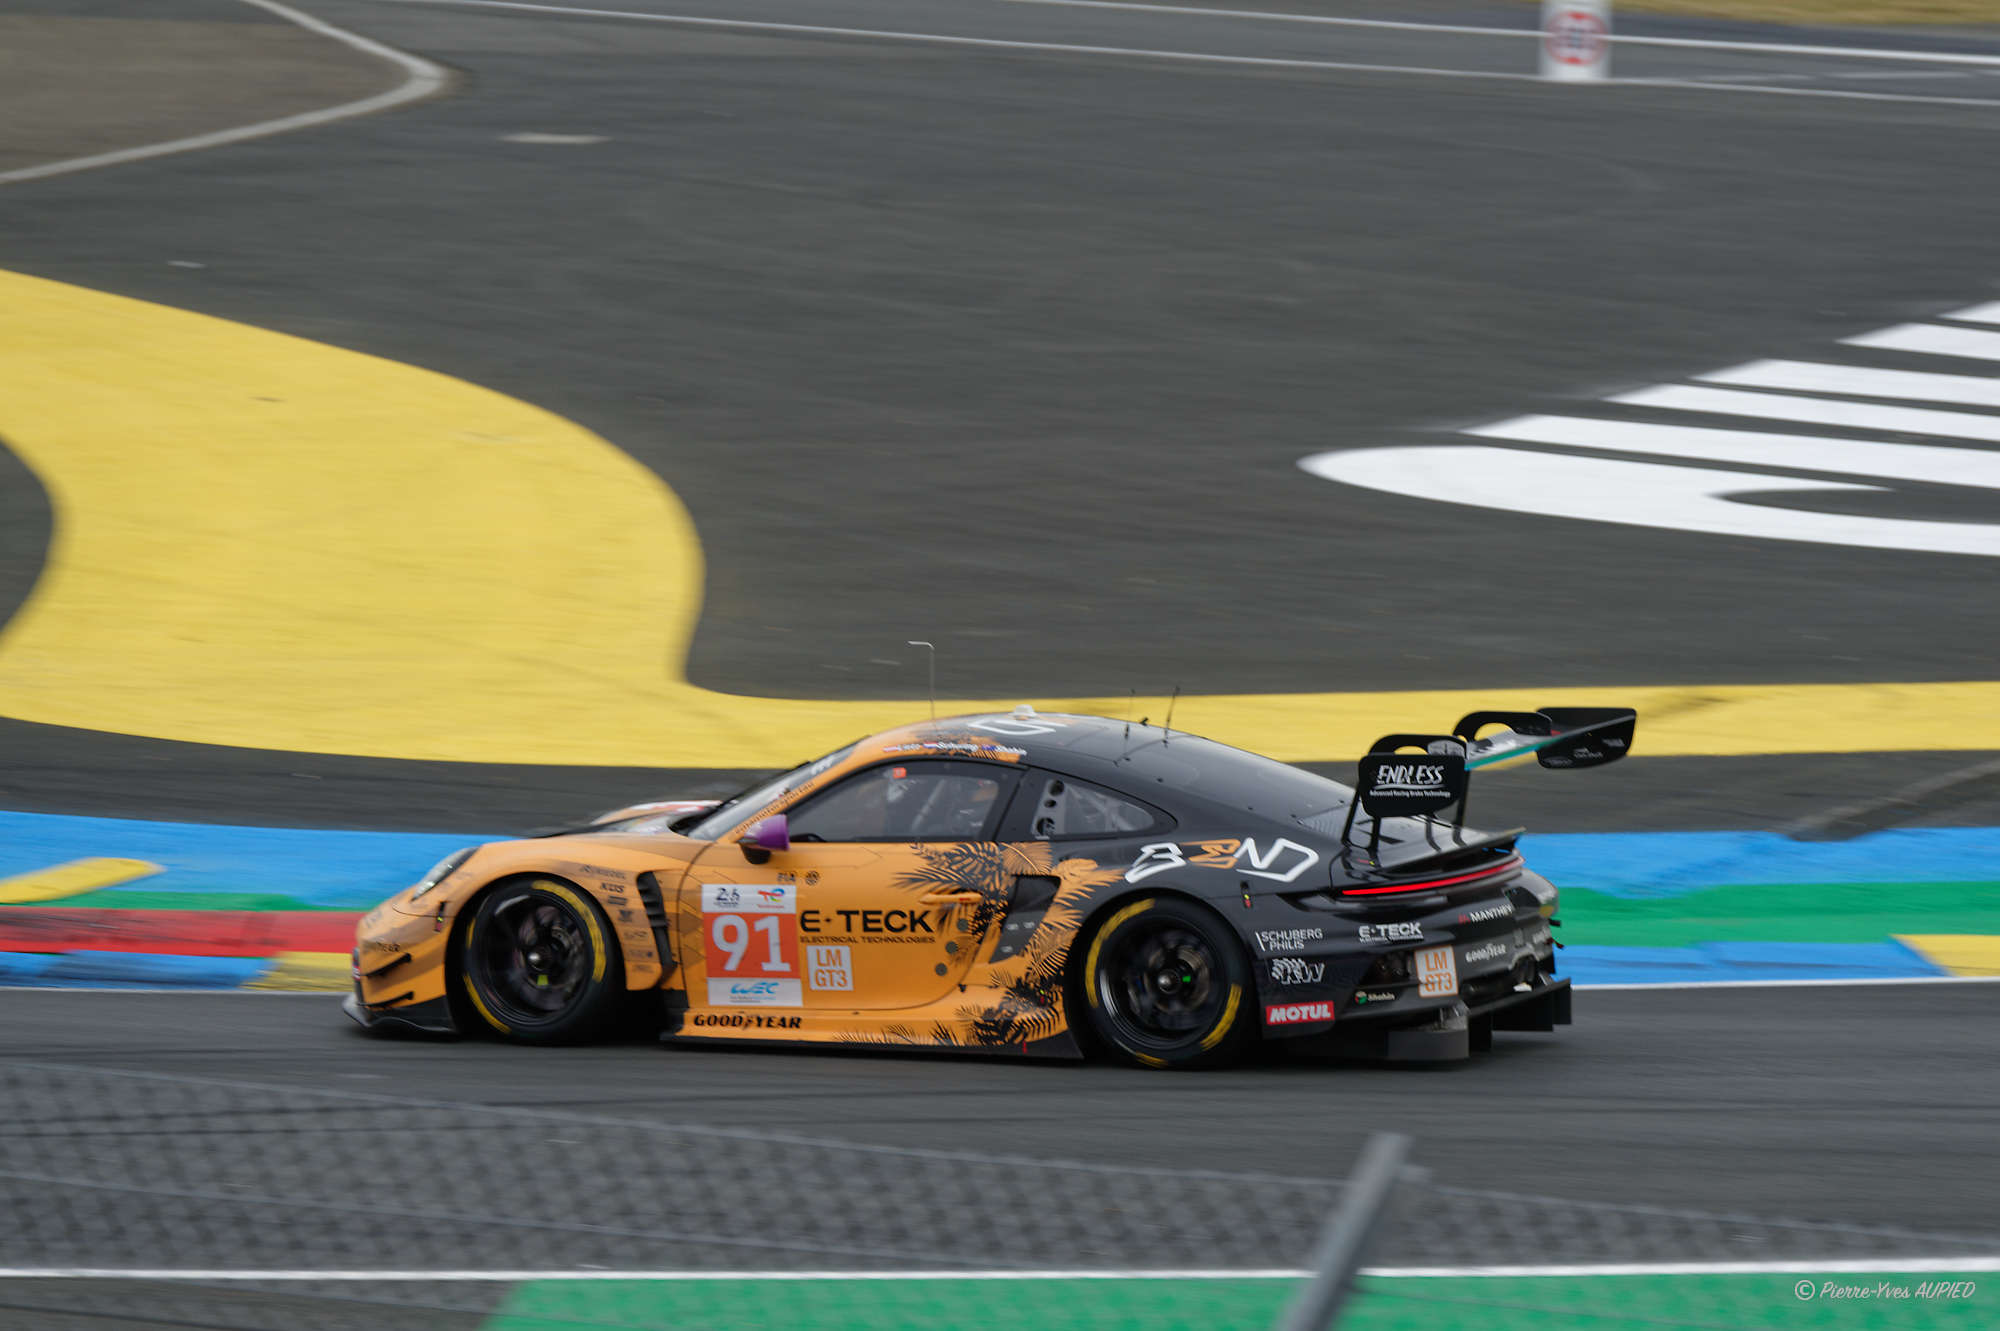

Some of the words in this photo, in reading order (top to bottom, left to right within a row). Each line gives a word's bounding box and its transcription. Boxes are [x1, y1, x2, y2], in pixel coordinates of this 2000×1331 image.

[1377, 765, 1445, 785] ENDLESS
[1470, 904, 1513, 922] MANTHEY
[711, 914, 792, 972] 91
[800, 935, 859, 944] ELECTRICAL
[861, 935, 936, 944] TECHNOLOGIES
[1261, 928, 1324, 942] SCHUBERG
[1269, 938, 1305, 951] PHILIS
[816, 948, 843, 967] LM
[1424, 950, 1448, 972] LM
[814, 969, 848, 988] GT3
[1425, 972, 1454, 992] GT3
[694, 1013, 802, 1030] GOODYEAR
[1270, 1004, 1331, 1023] MOTUL
